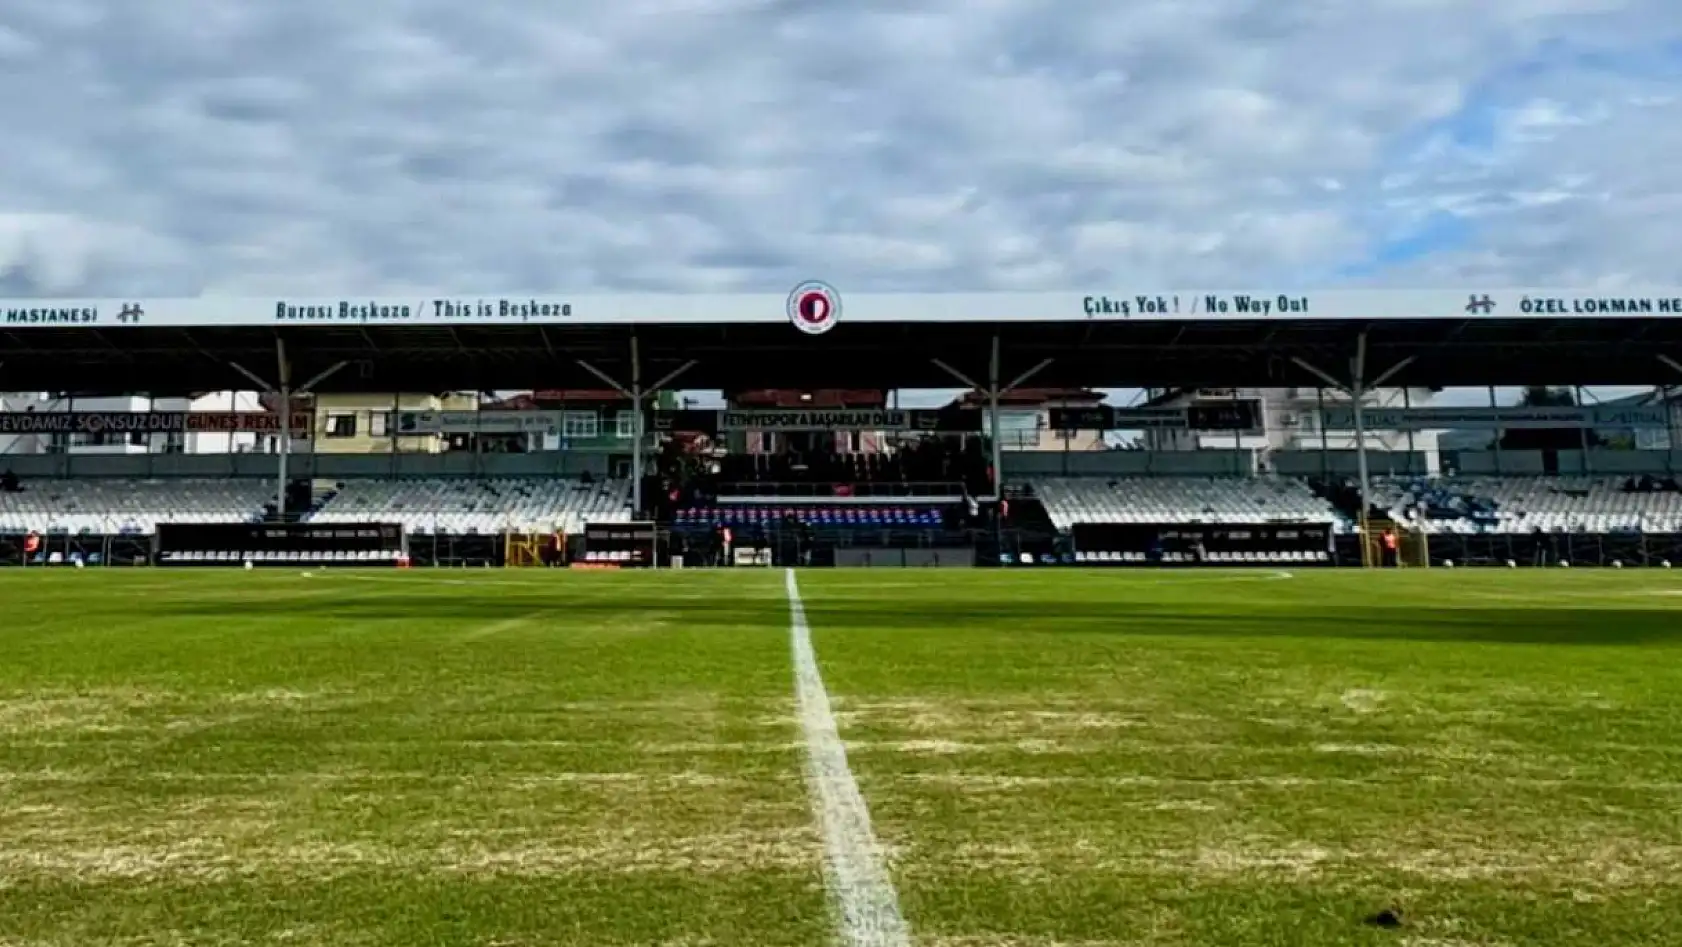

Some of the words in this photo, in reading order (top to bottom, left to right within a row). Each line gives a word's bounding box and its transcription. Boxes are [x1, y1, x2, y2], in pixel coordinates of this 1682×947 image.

[6, 304, 98, 323] HASTANESİ
[276, 301, 332, 319] Burası
[433, 300, 471, 317] This
[477, 300, 493, 317] is
[1135, 296, 1168, 313] Yok
[1205, 295, 1228, 313] No
[1233, 295, 1272, 316] Way
[1278, 294, 1309, 313] Out
[1520, 296, 1567, 313] ÖZEL
[1573, 299, 1652, 313] LOKMAN
